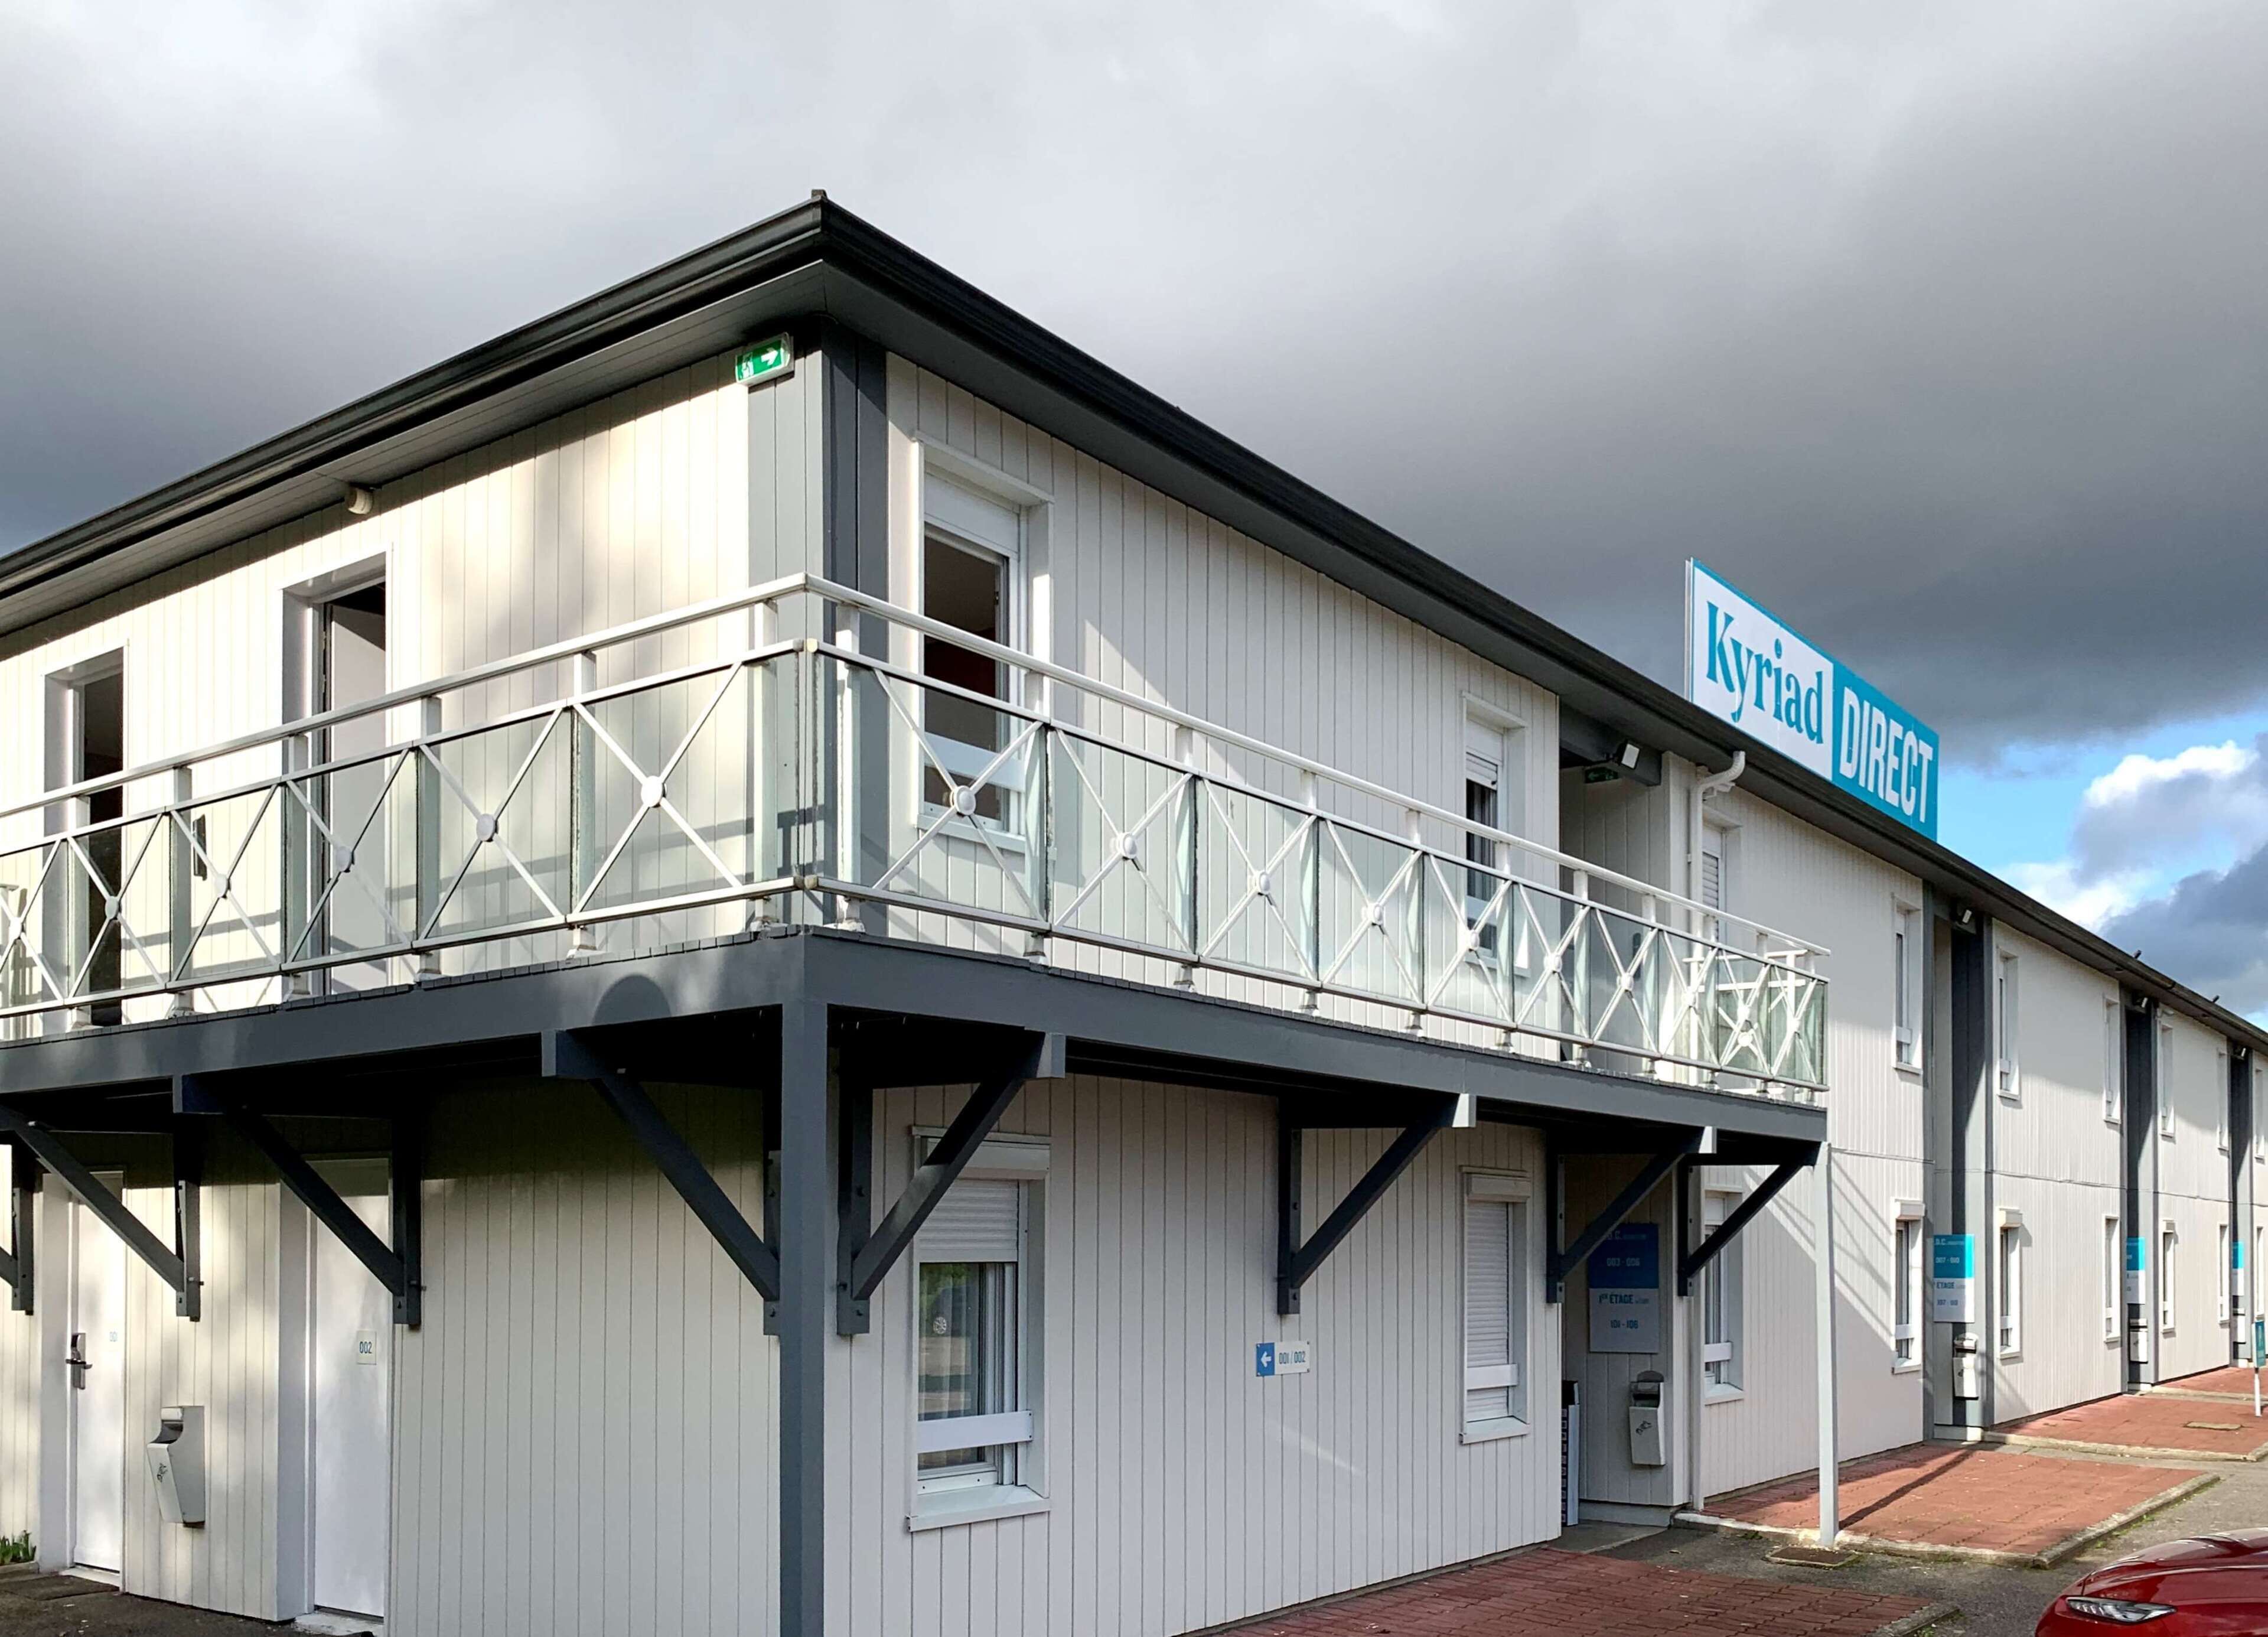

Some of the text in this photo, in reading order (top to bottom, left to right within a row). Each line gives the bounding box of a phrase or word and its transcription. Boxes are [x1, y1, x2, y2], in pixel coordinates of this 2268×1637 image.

[1706, 601, 1934, 823] Kyriad DIRECT
[359, 1341, 373, 1354] 002
